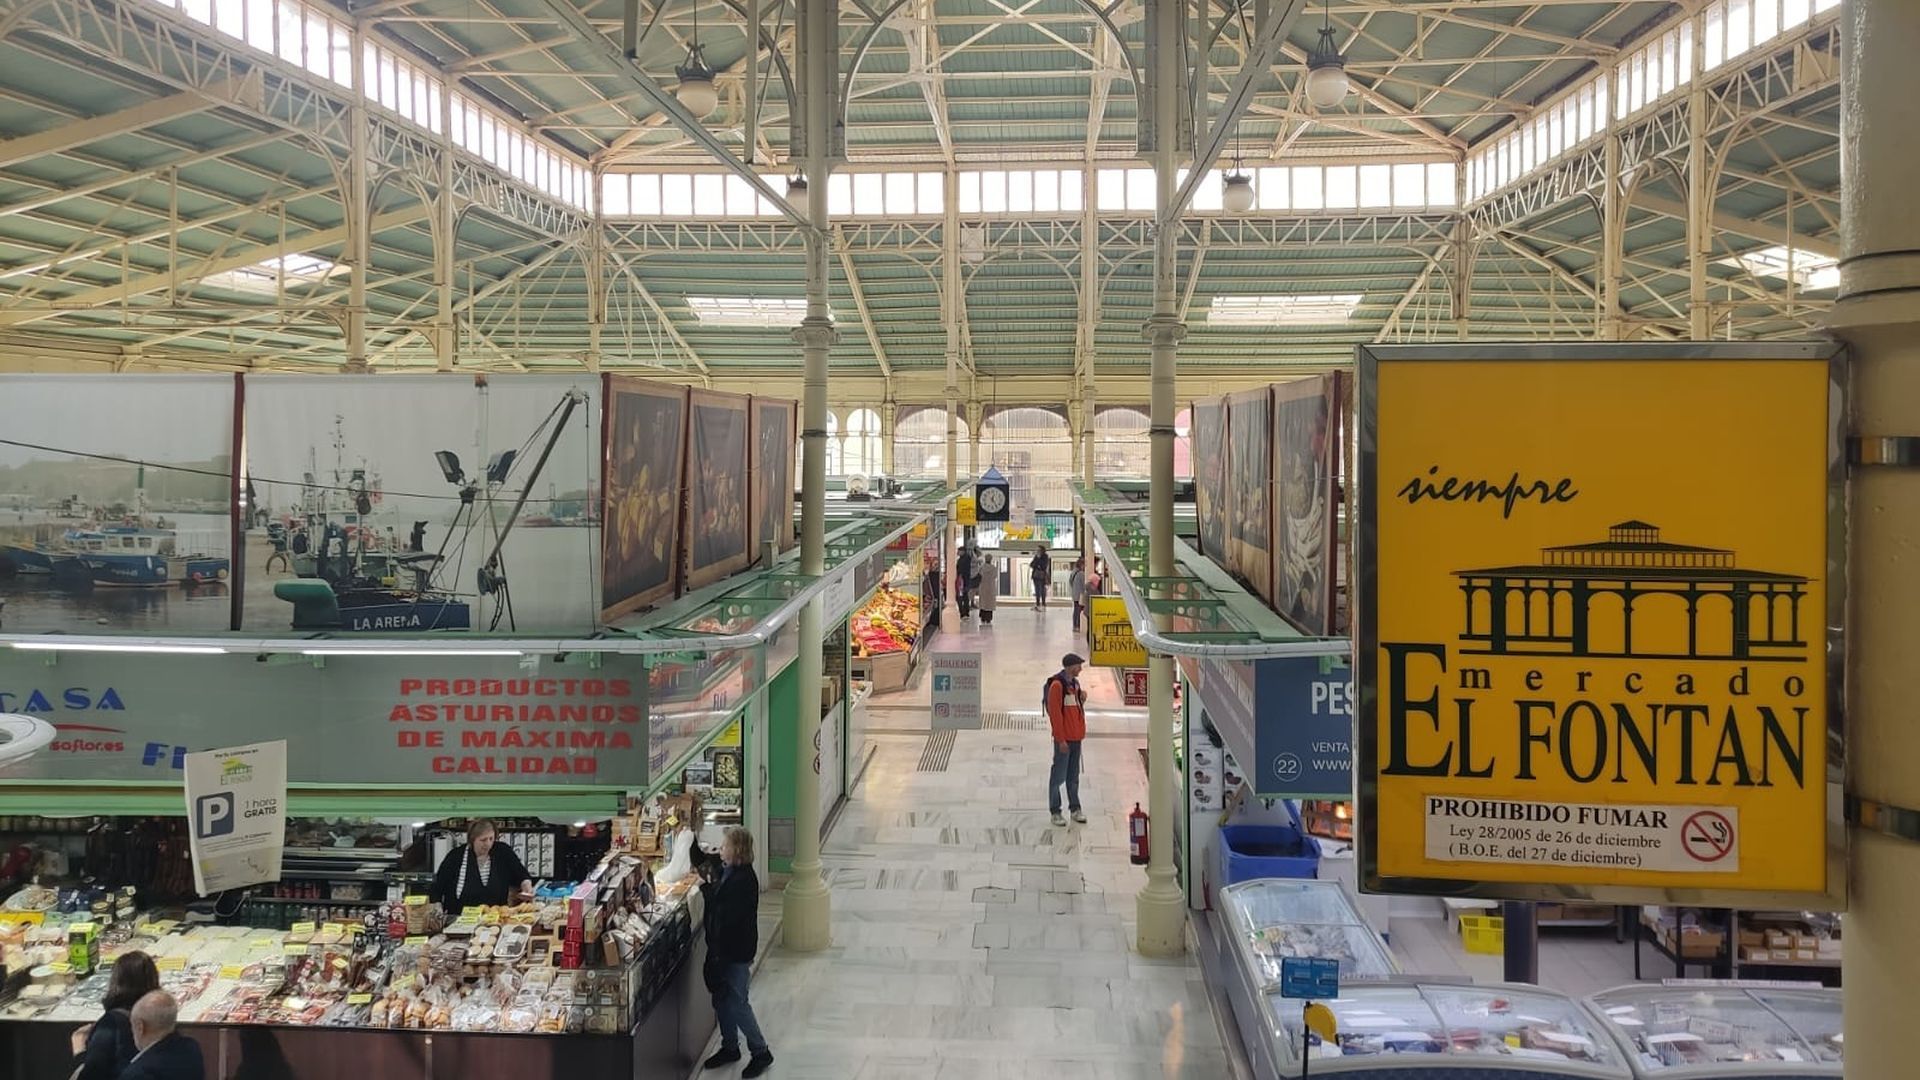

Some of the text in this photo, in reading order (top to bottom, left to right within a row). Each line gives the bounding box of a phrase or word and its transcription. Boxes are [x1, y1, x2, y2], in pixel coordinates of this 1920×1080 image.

[1397, 465, 1579, 519] siempre
[353, 618, 372, 631] LA
[400, 679, 632, 697] PRODUCTOS
[1458, 665, 1805, 698] mercado
[389, 705, 642, 723] ASTURIANOS
[1380, 641, 1810, 790] EL FONTAN
[397, 725, 634, 749] DE MÁXIMA
[1311, 741, 1350, 753] VENTA
[431, 756, 598, 774] CALIDAD
[1277, 759, 1297, 774] 22
[244, 806, 277, 818] GRATIS
[252, 798, 277, 808] hora
[1429, 798, 1668, 828] PROHIBIDO FUMAR
[202, 796, 229, 835] P
[1450, 824, 1662, 848] Ley 28/2005 de 26 de diciembre
[1507, 846, 1526, 859] del
[1531, 848, 1547, 860] 27
[1551, 849, 1567, 861] de
[1571, 850, 1643, 868] diciembre)
